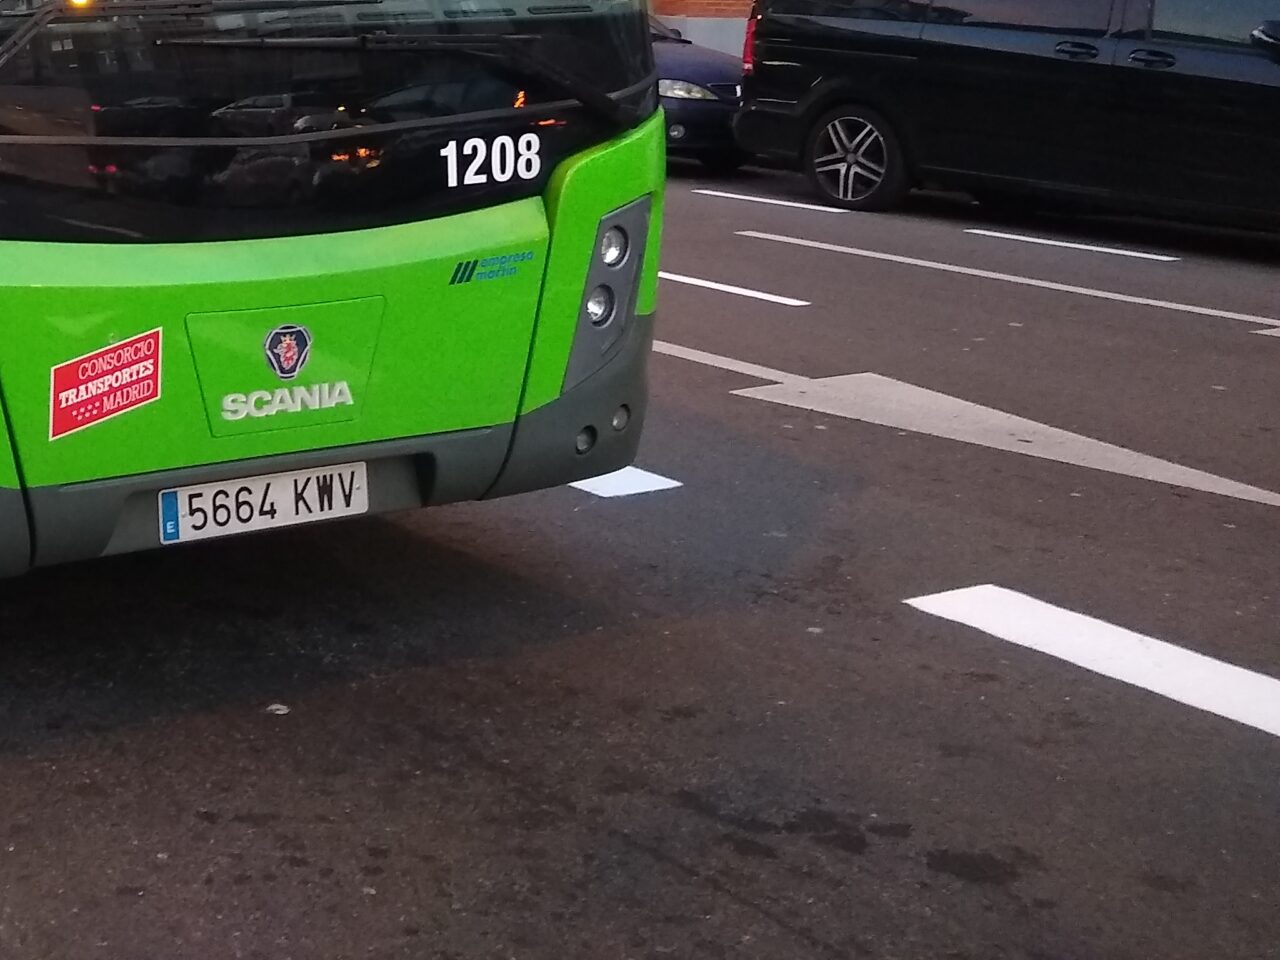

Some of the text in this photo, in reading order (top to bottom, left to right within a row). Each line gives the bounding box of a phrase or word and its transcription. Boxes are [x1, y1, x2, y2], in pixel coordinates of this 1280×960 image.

[440, 132, 541, 188] 1208
[480, 250, 534, 268] empresa
[78, 338, 155, 380] CONSORCIO
[58, 358, 155, 409] TRANSPORTES
[102, 379, 155, 413] MADRID
[221, 380, 354, 421] SCANIA
[166, 470, 356, 533] E 5664 KWV
